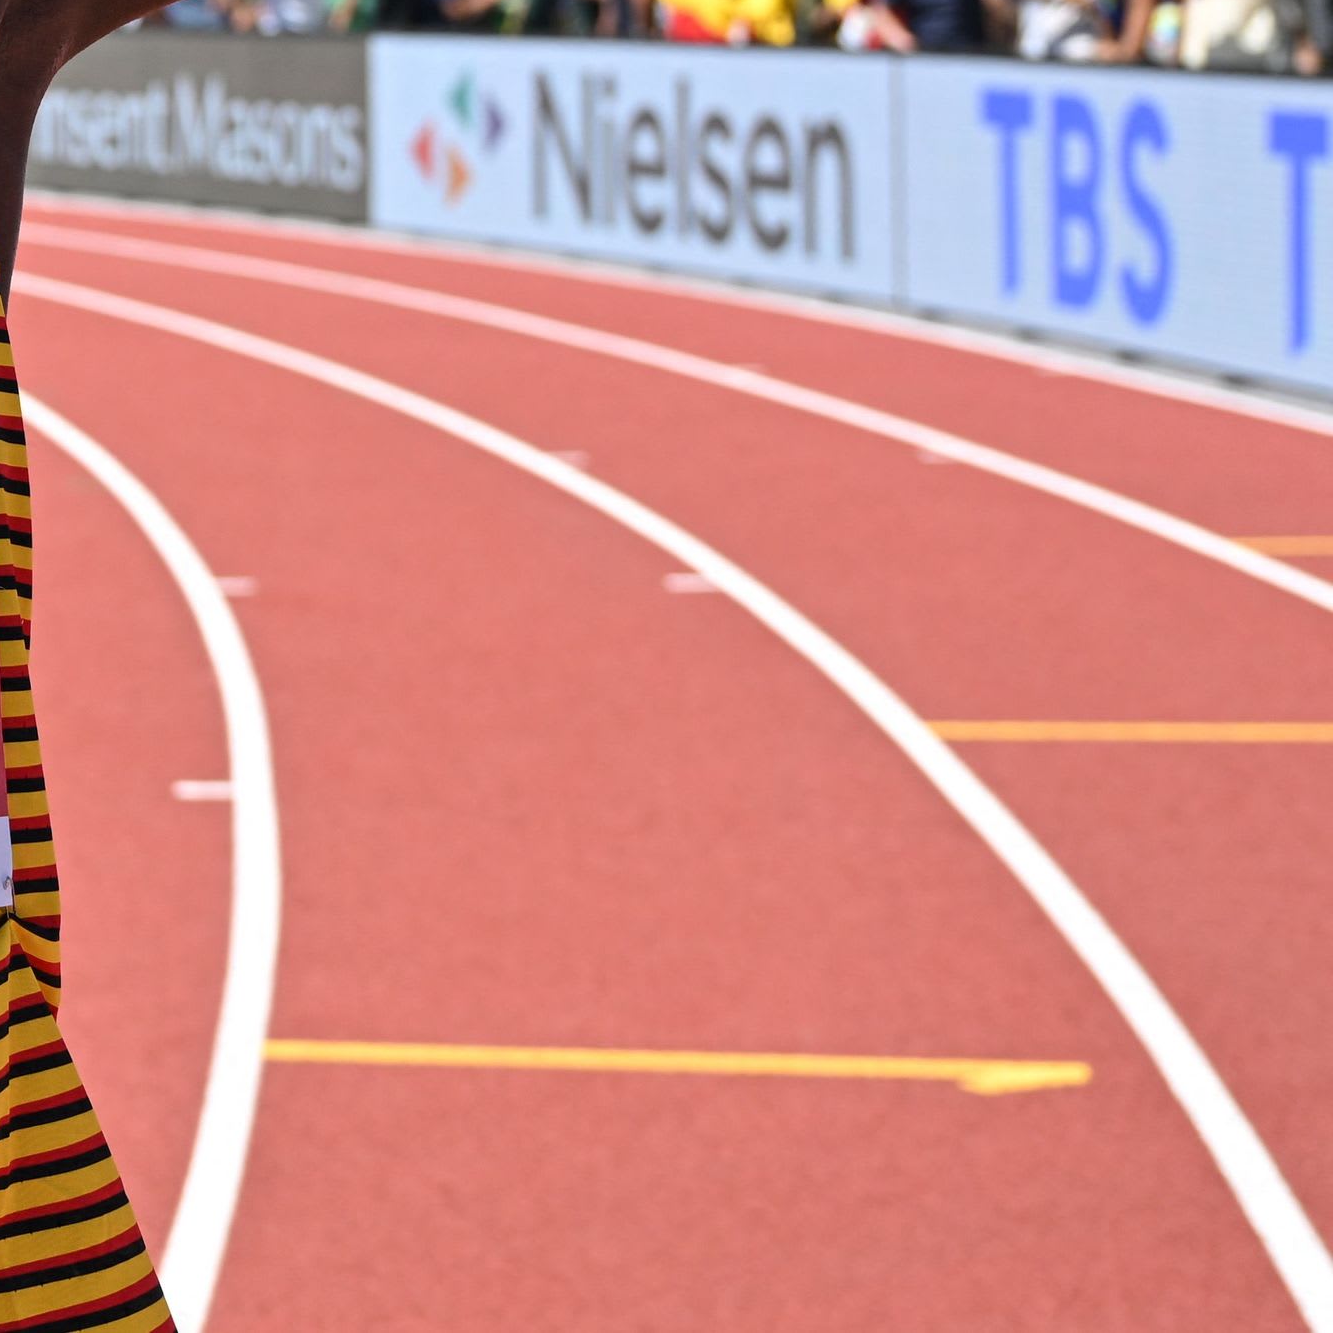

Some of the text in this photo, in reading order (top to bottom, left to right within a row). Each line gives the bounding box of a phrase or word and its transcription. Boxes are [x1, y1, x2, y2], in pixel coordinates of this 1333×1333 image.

[171, 71, 365, 193] Masons
[531, 68, 859, 258] Nielsen
[979, 84, 1175, 326] TBS
